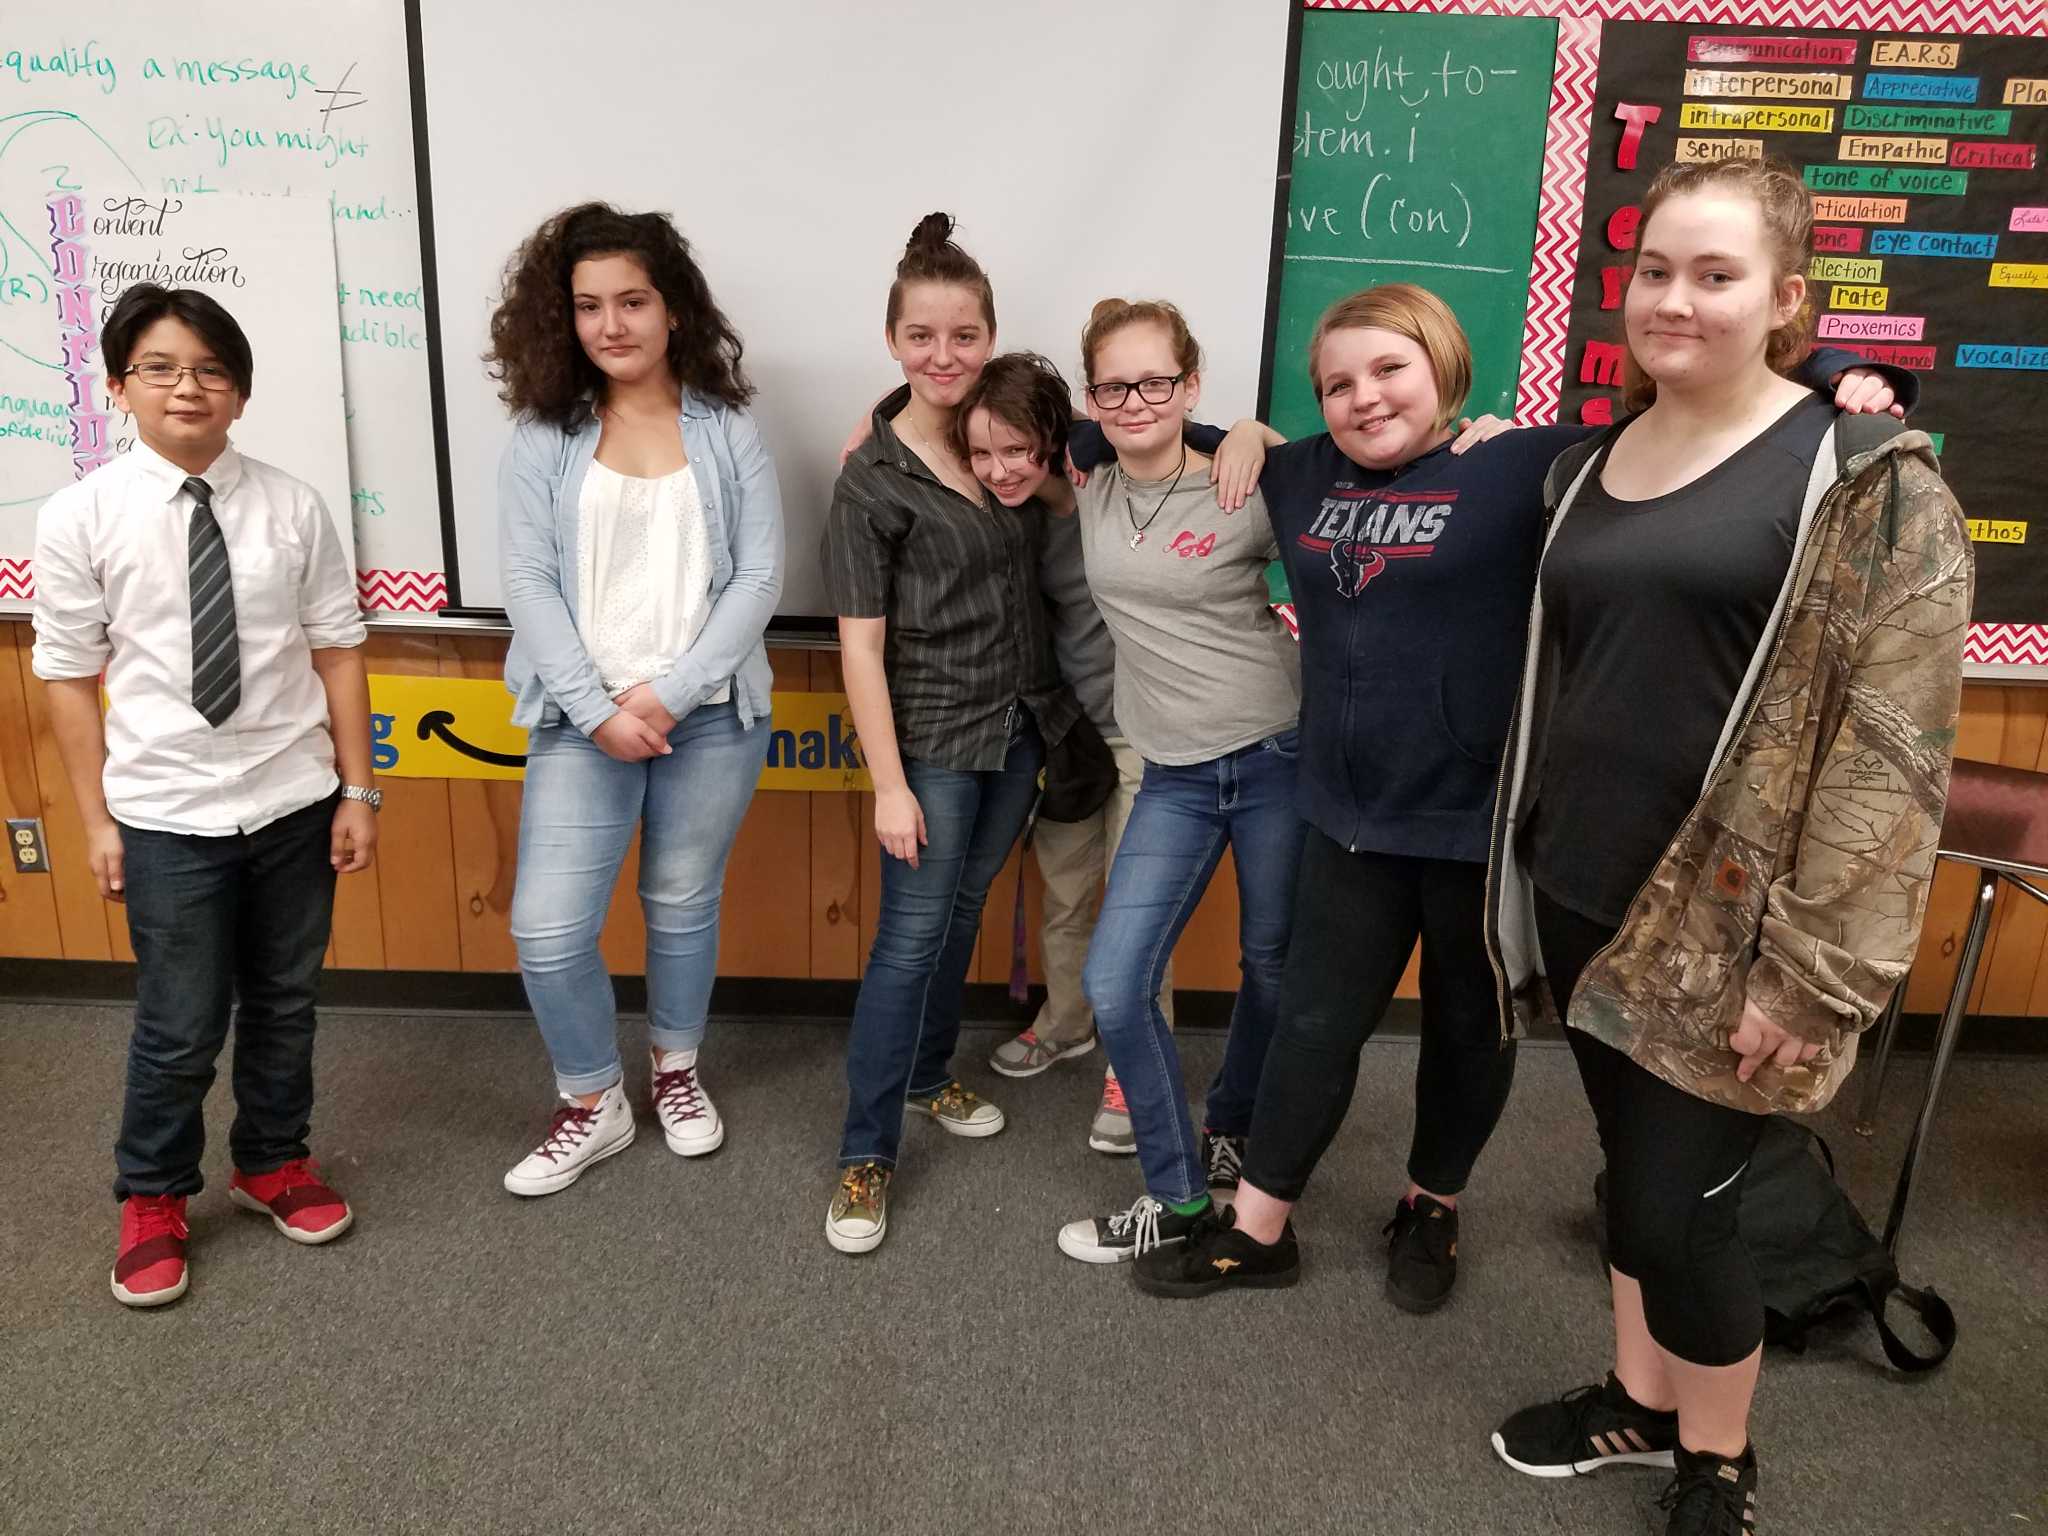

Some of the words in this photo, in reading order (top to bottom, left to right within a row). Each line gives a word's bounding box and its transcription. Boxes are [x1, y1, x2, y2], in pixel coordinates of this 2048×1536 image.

[1695, 38, 1843, 61] Communication
[1875, 43, 1954, 66] E.A.R.S.
[6, 39, 117, 94] qualify
[144, 58, 165, 79] a
[176, 58, 317, 99] message
[1316, 46, 1415, 122] ought
[1692, 72, 1842, 97] interpersonal
[1869, 76, 1975, 100] Appreciative
[1689, 106, 1831, 130] intrapersonal
[1851, 108, 1995, 131] Discriminative
[276, 128, 369, 169] might
[1685, 139, 1760, 160] sender
[1811, 167, 1859, 187] tone
[1870, 168, 1894, 188] of
[1900, 174, 1953, 190] voice
[1874, 233, 1911, 253] eye
[1918, 235, 1995, 257] contact
[359, 285, 423, 313] need
[1835, 287, 1885, 307] rate
[1826, 317, 1918, 338] Proxemics
[1308, 497, 1453, 545] TEXANS
[1968, 520, 2024, 542] thos
